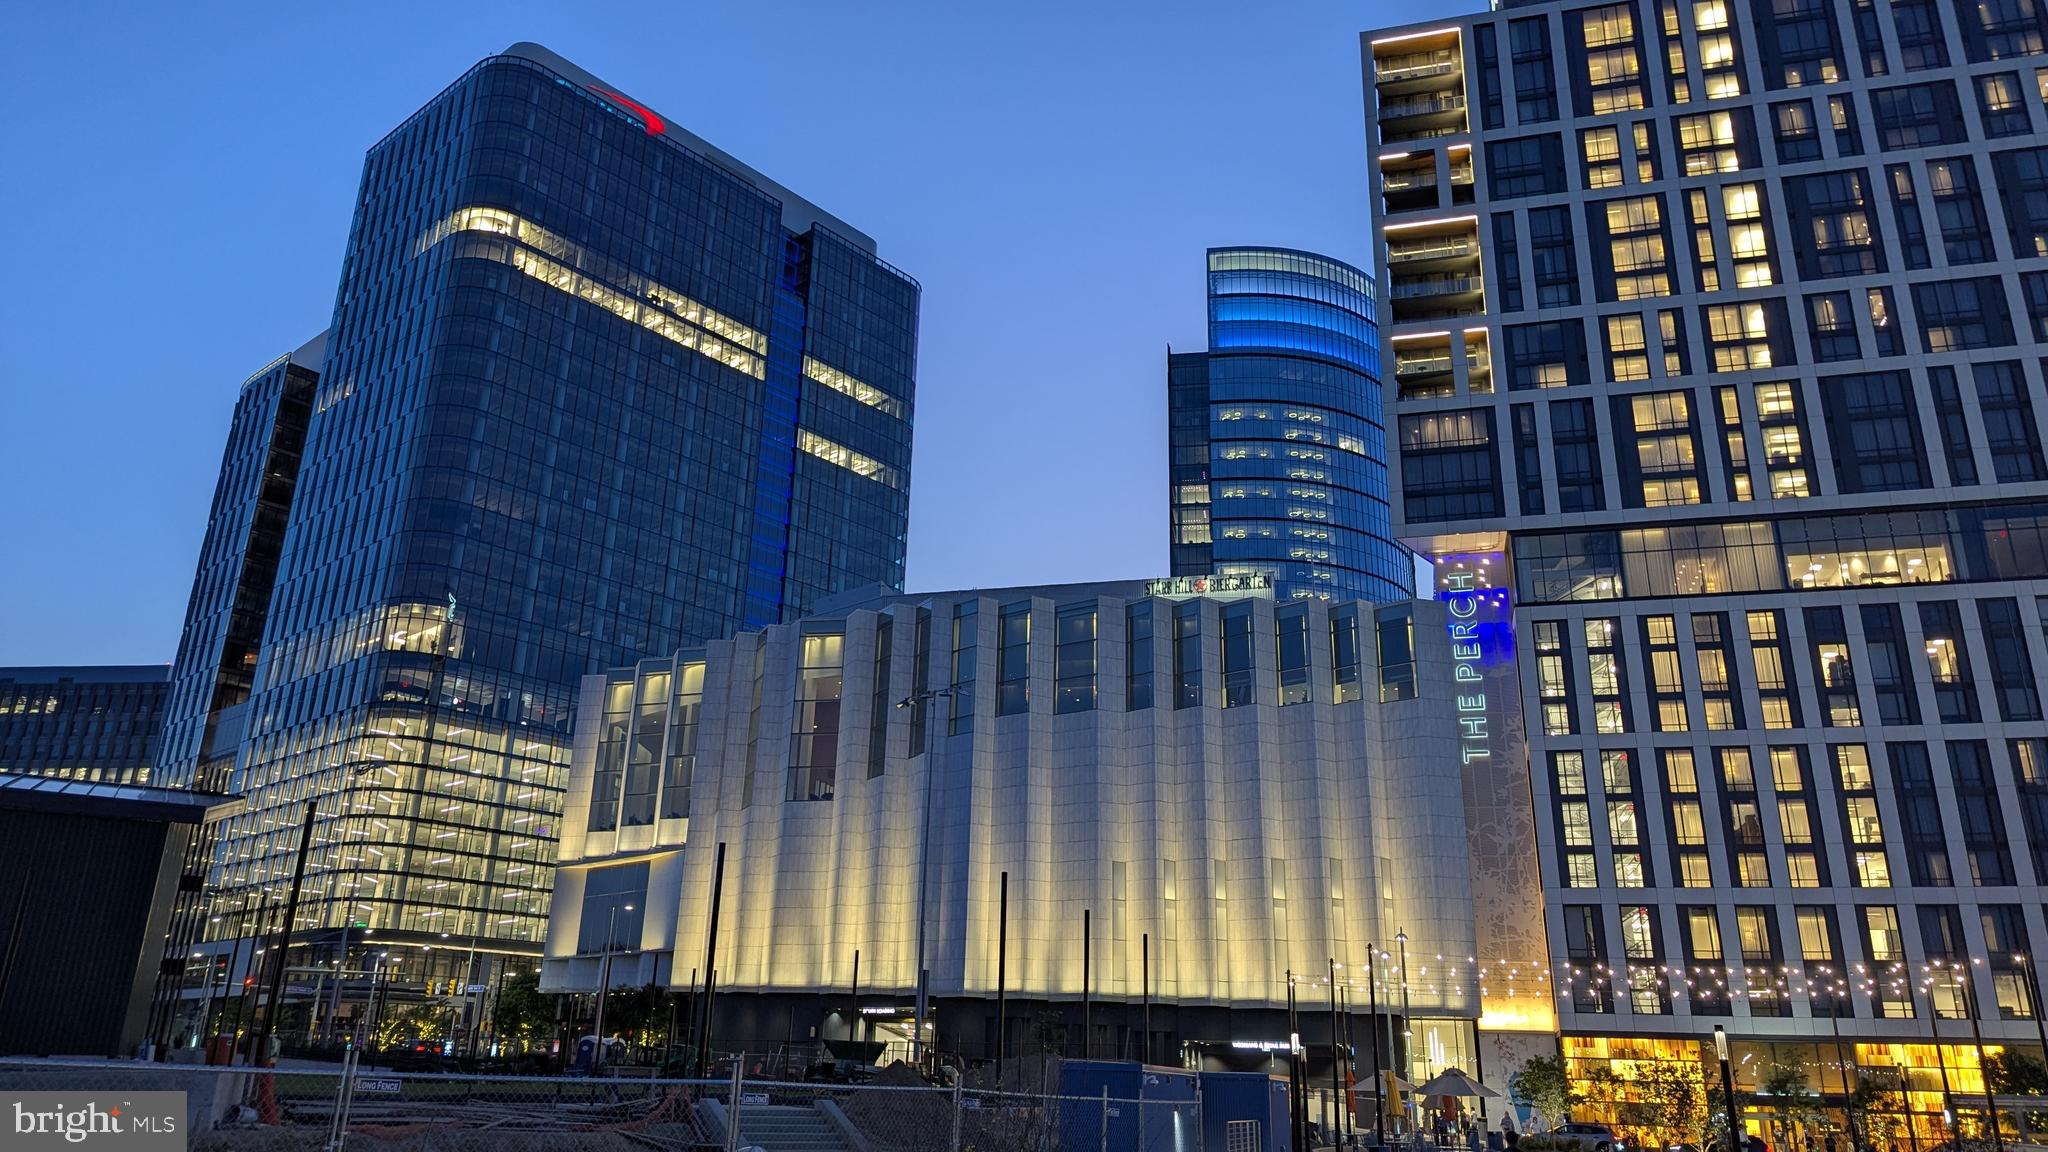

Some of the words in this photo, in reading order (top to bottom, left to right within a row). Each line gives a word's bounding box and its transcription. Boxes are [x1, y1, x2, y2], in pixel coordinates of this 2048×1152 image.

[1174, 579, 1193, 594] HILL
[1209, 575, 1272, 593] BIERGARTEN
[1447, 572, 1483, 683] PERCH
[1458, 693, 1491, 765] THE
[357, 1080, 376, 1090] LONG
[376, 1080, 399, 1091] FENCE
